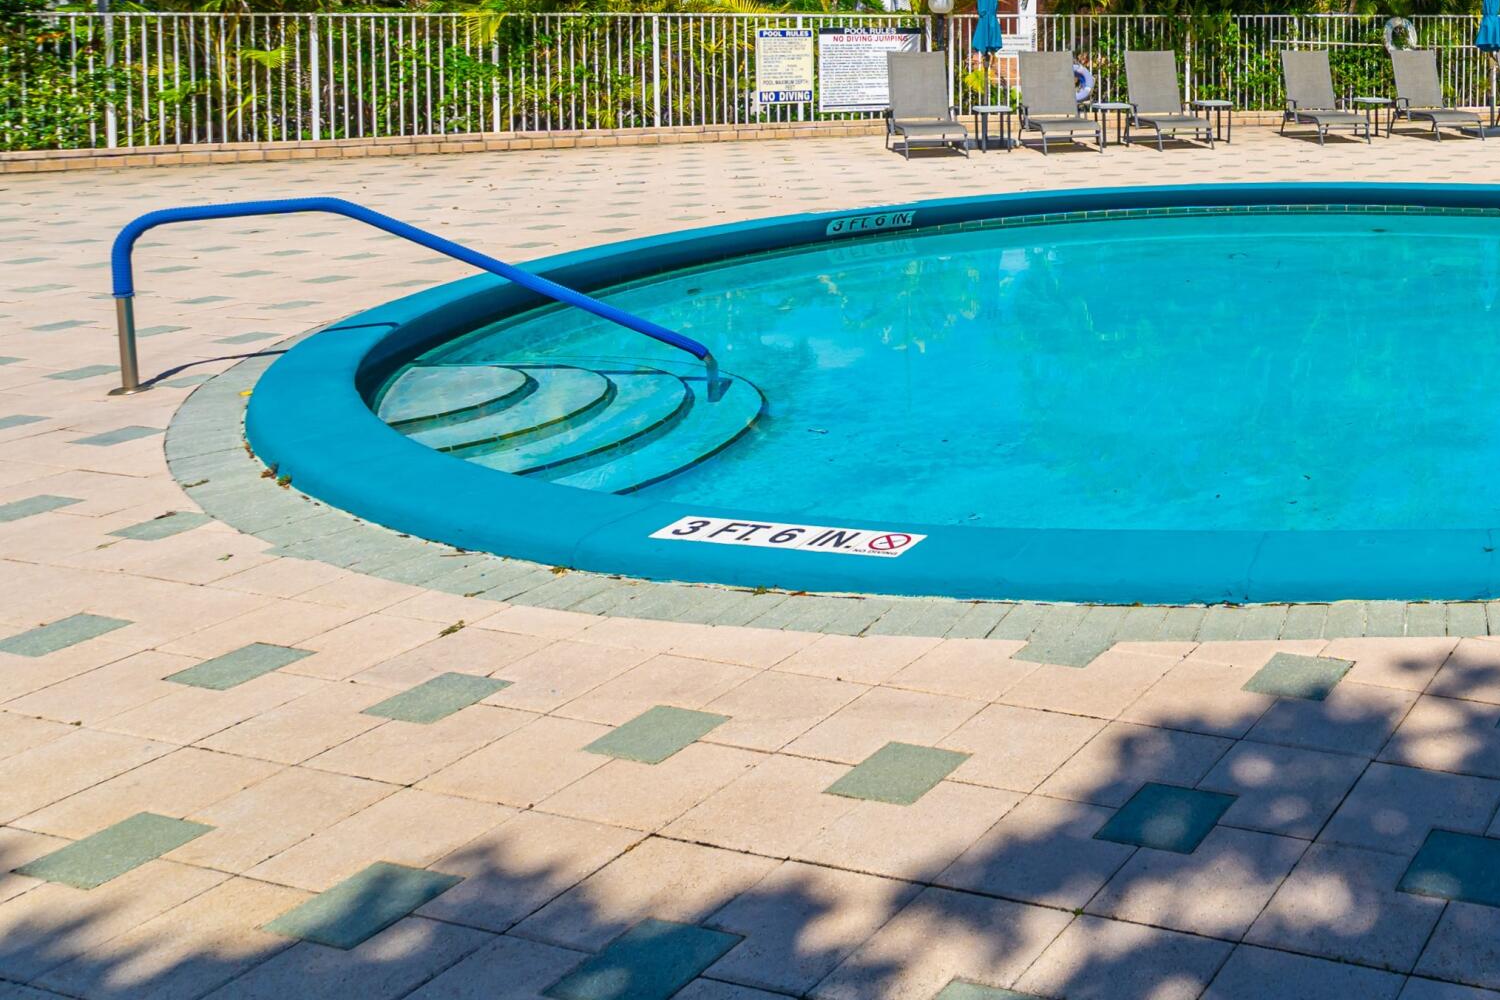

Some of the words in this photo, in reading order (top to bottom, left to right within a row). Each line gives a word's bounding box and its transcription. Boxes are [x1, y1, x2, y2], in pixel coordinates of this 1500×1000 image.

[762, 92, 776, 101] NO
[779, 90, 810, 100] DIVING
[832, 220, 844, 232] 3
[849, 216, 870, 230] FT.
[875, 215, 887, 226] 6
[892, 212, 911, 225] IN.
[672, 519, 711, 536] 3
[707, 522, 772, 541] FT.
[768, 528, 806, 544] 6
[808, 530, 862, 549] IN.
